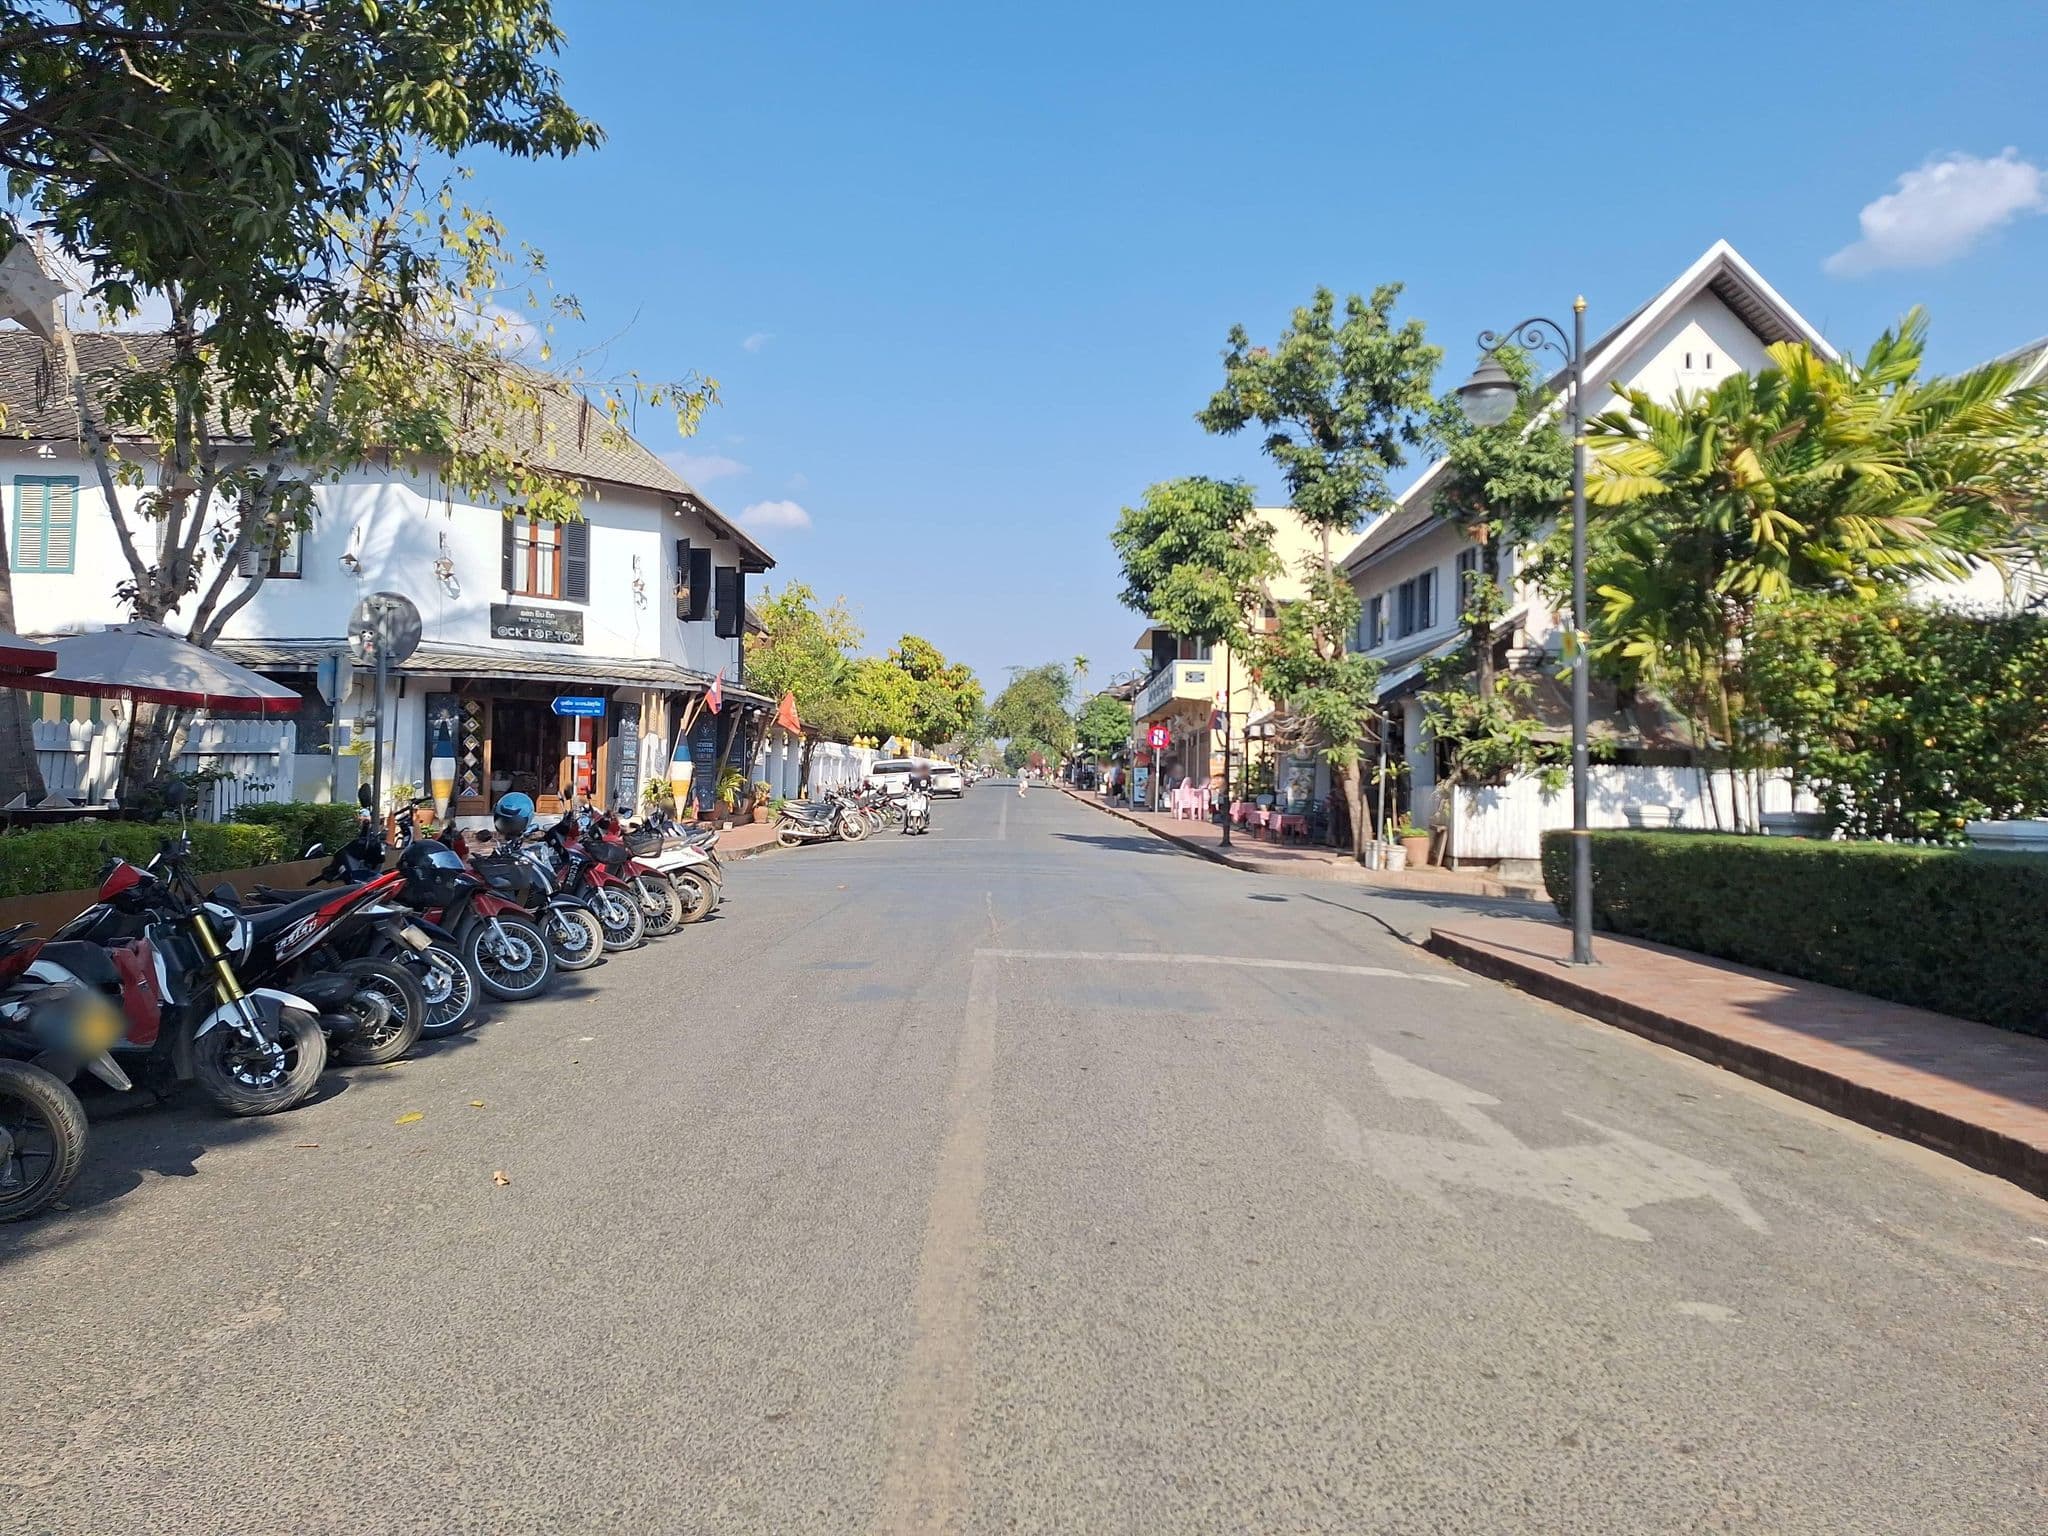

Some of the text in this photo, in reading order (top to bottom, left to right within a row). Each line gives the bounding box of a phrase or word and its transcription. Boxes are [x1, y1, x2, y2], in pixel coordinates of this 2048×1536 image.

[497, 626, 579, 643] OCK POP TOK
